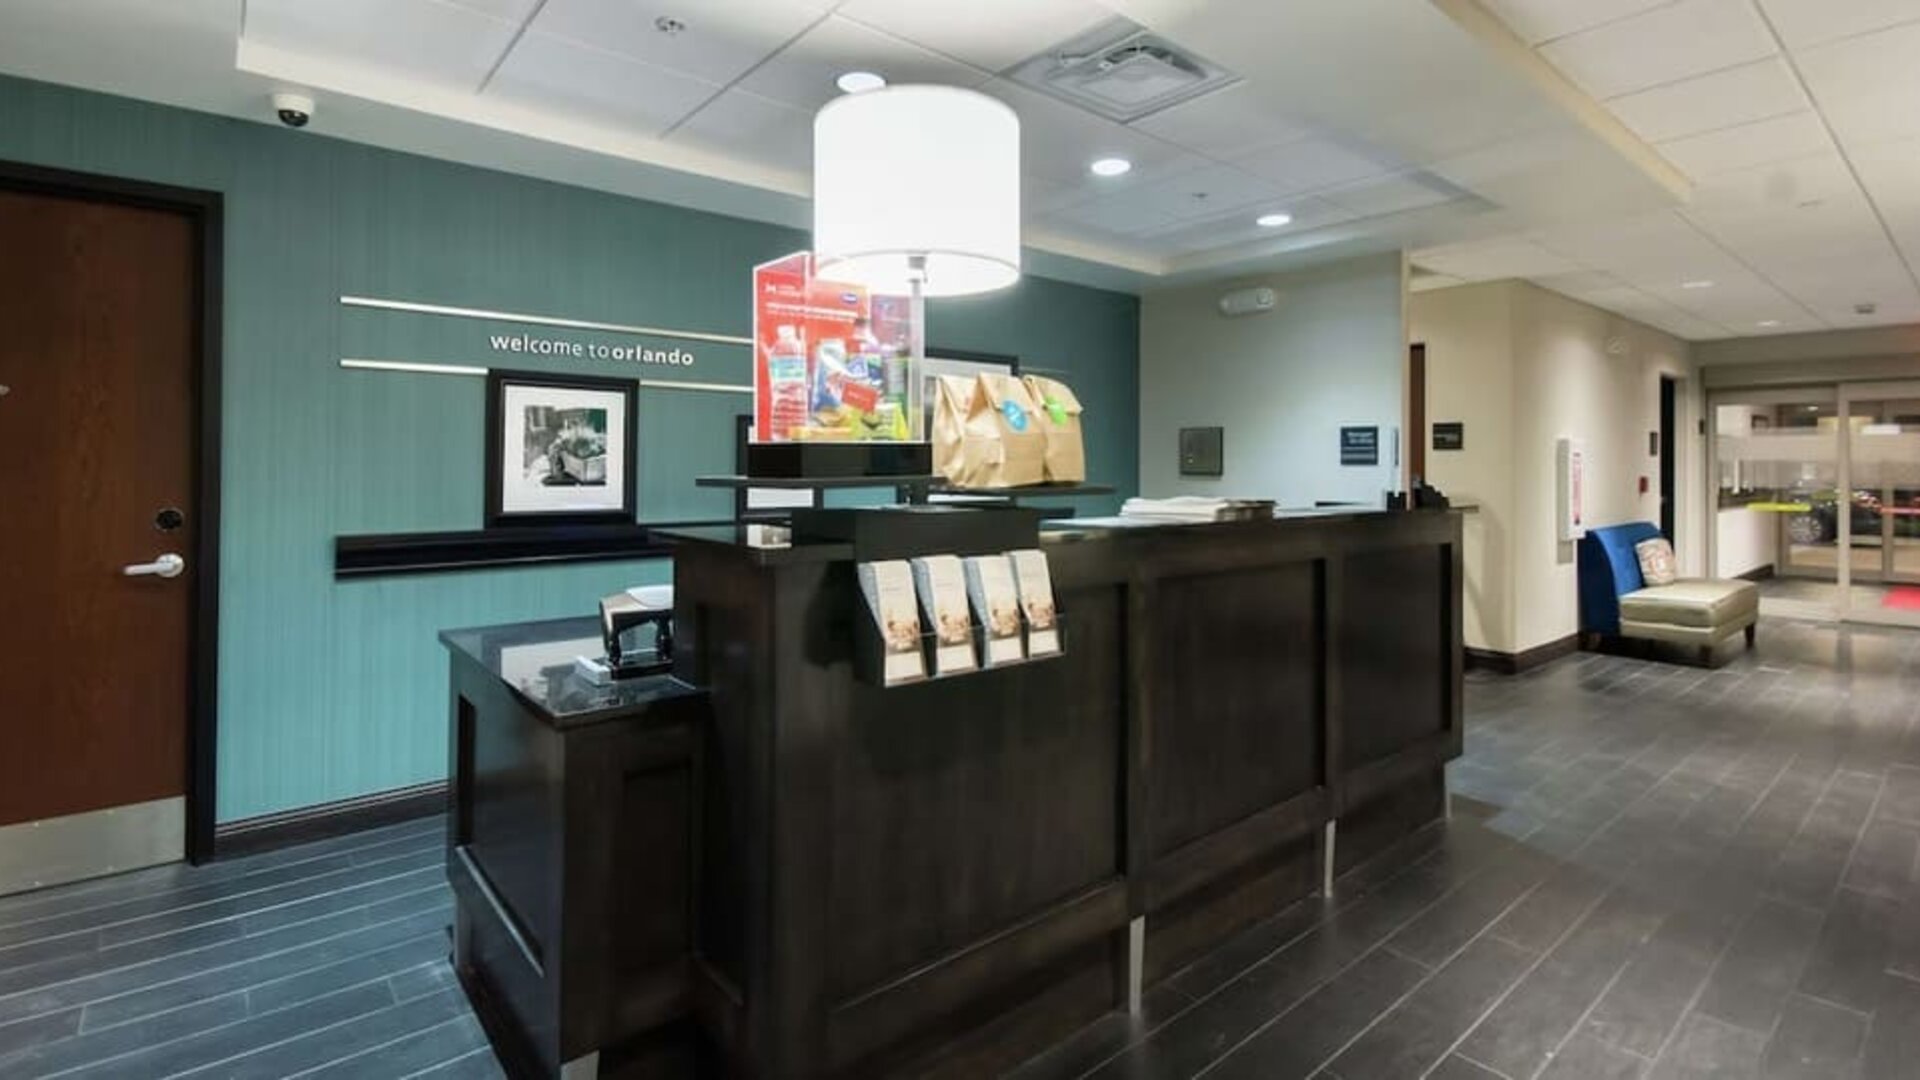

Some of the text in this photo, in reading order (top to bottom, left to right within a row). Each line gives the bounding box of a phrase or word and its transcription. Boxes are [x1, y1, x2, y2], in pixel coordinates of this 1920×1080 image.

[489, 333, 695, 366] welcome to orlando
